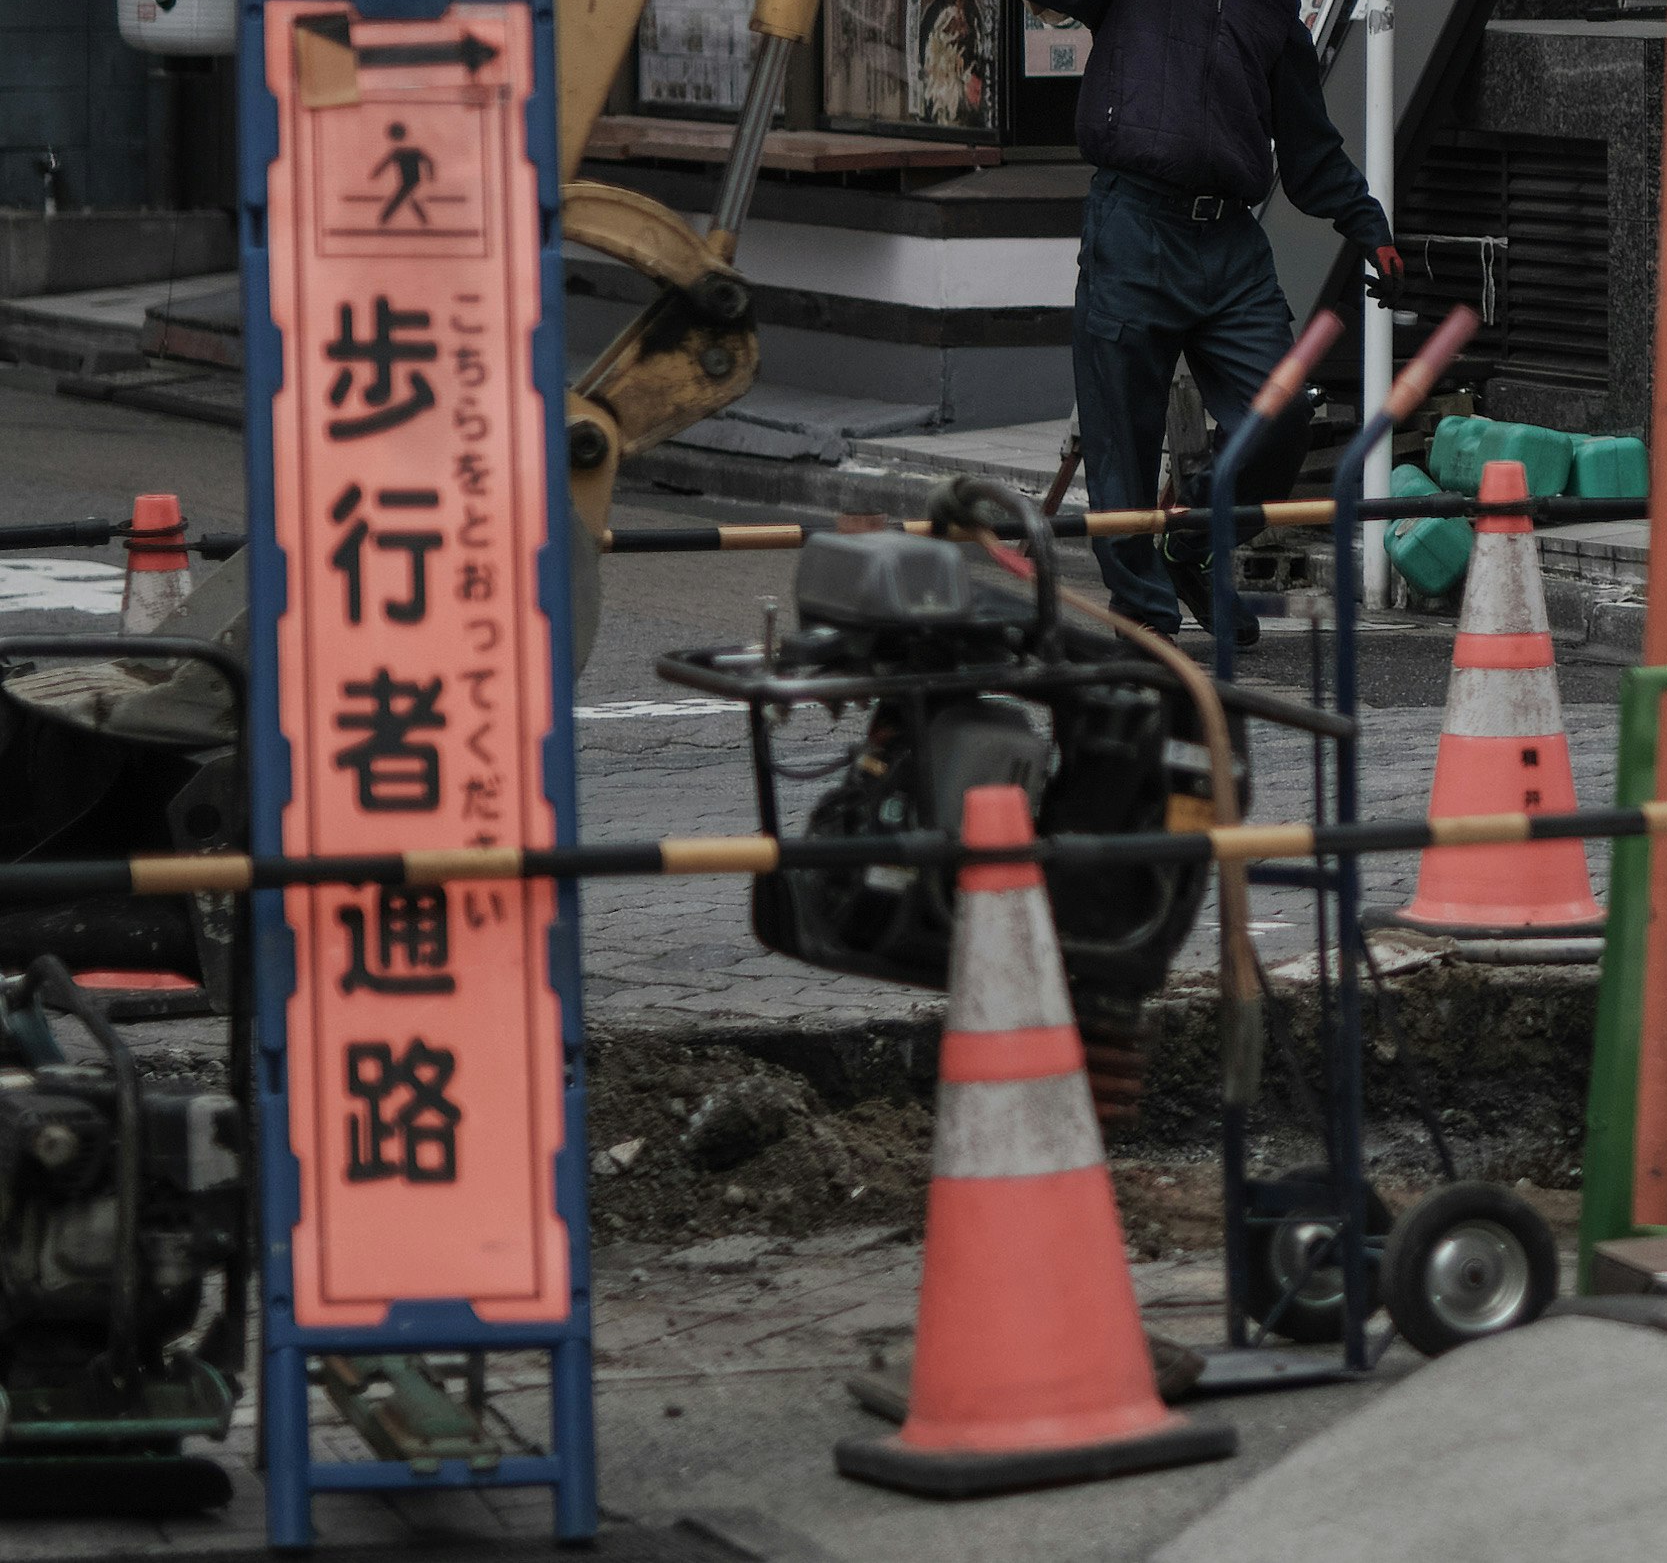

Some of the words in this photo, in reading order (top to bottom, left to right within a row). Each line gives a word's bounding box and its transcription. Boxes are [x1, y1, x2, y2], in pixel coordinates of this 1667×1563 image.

[324, 294, 462, 1186] 歩行者通路
